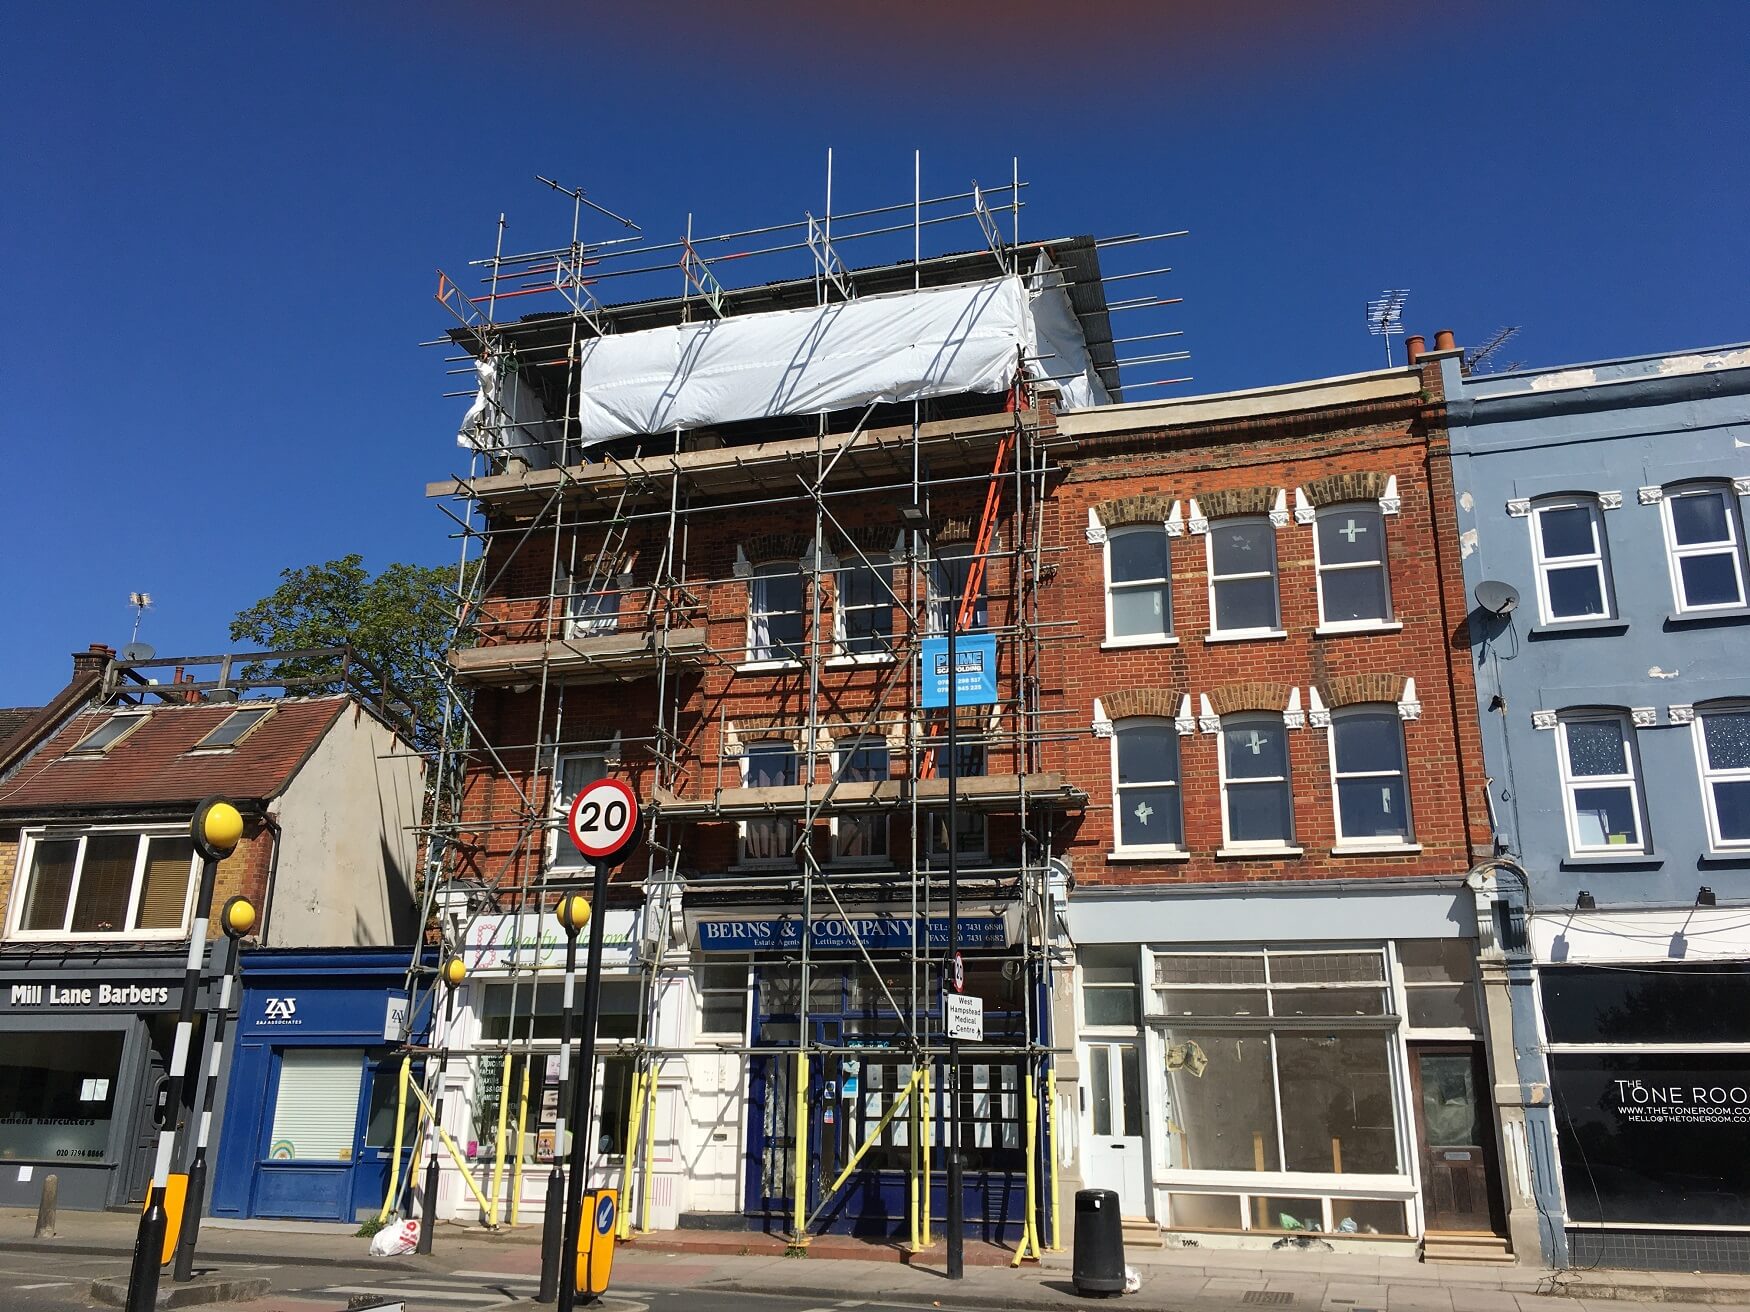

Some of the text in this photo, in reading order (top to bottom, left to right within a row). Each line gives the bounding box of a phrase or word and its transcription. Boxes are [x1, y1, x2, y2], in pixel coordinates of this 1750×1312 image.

[936, 652, 982, 667] PIME
[936, 665, 982, 674] SCAOLDING
[580, 801, 627, 831] 20
[707, 920, 914, 938] BERNS & COMPANY
[929, 923, 948, 931] TEL:
[965, 923, 982, 931] 7431
[984, 923, 1004, 931] 6880
[815, 938, 869, 946] Lettings Agnts
[929, 934, 949, 942] FAX:
[966, 934, 983, 942] 7431
[985, 934, 1005, 942] 6882
[754, 938, 801, 948] Estate Agents
[11, 984, 168, 1004] Mill Lane Barbers
[959, 997, 973, 1006] West
[264, 998, 297, 1019] ZAJ
[950, 1005, 981, 1016] Hampstead
[954, 1016, 977, 1025] Medical
[956, 1024, 975, 1034] Centre
[1692, 1087, 1750, 1104] ROO
[37, 1118, 95, 1126] haircutters
[1628, 1115, 1750, 1123] HELLO@THETONEROOM.CO.
[56, 1149, 68, 1157] 020
